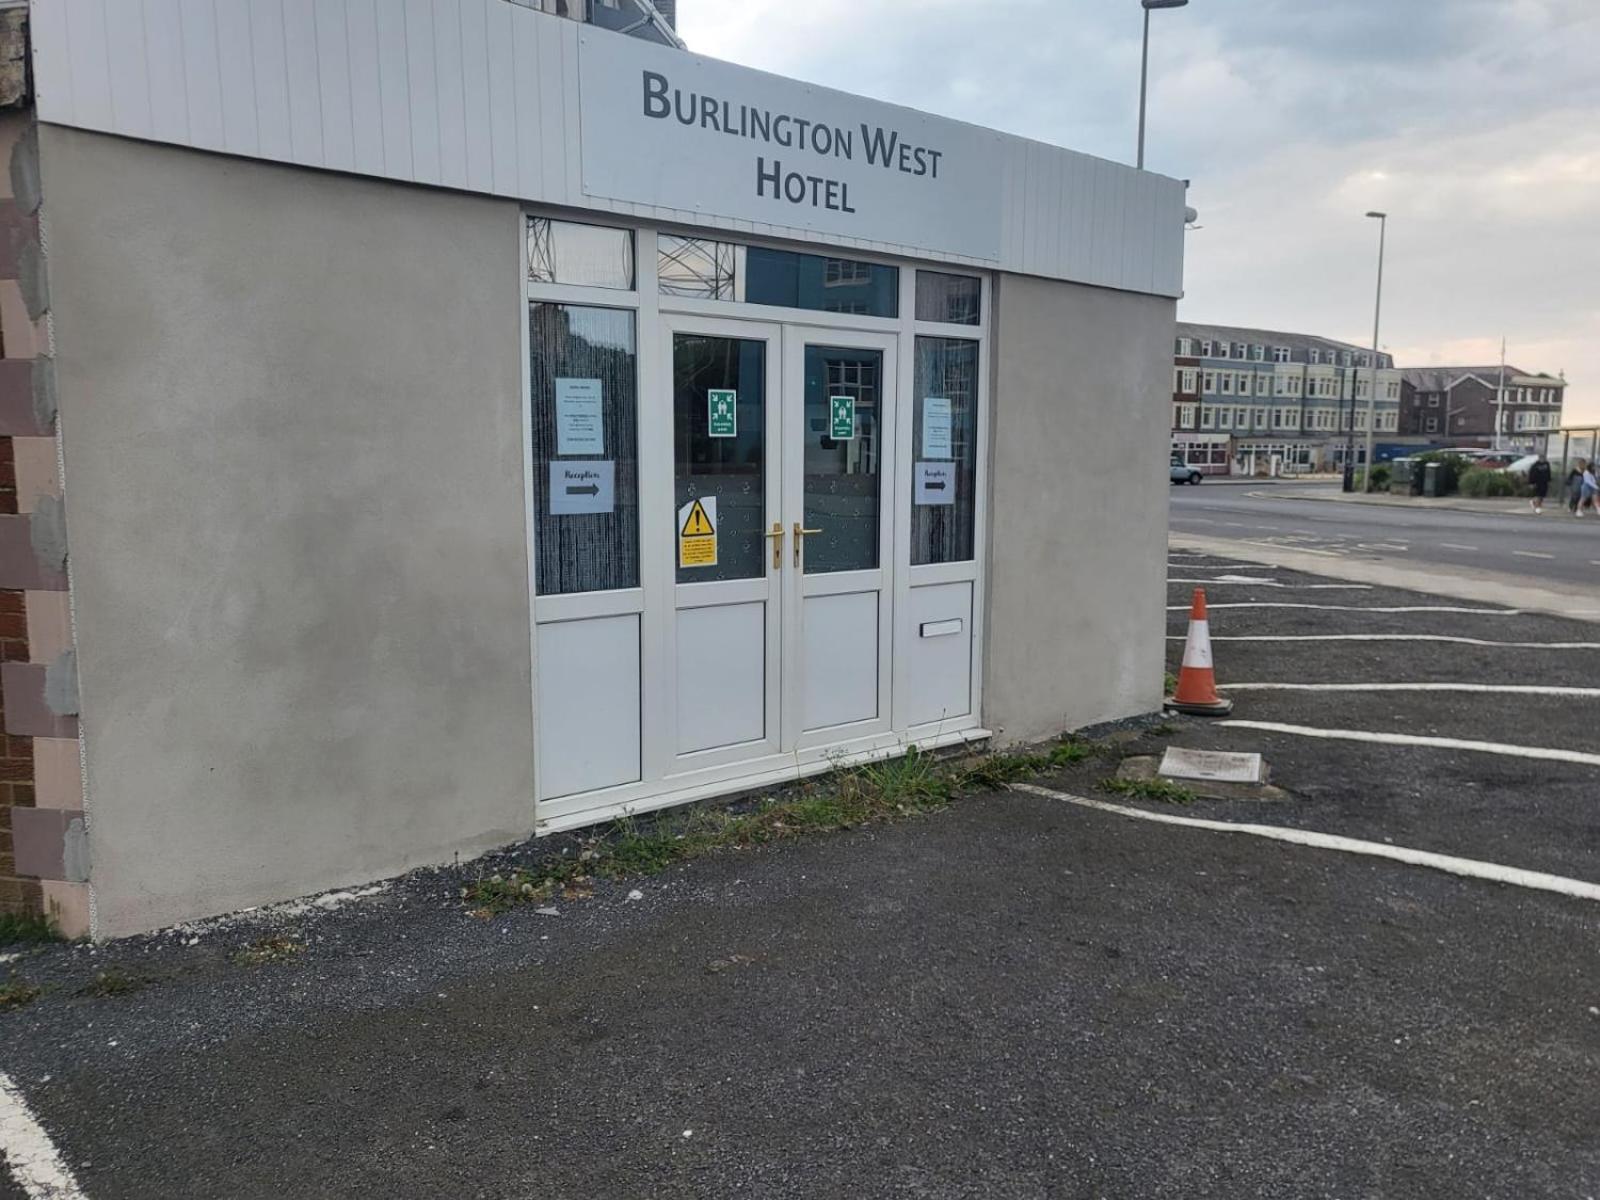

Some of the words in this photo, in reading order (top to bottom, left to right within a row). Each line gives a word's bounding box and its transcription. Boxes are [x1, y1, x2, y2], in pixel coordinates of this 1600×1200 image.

[642, 70, 853, 161] BURLINGTON
[860, 123, 943, 179] WEST
[756, 156, 856, 214] HOTEL
